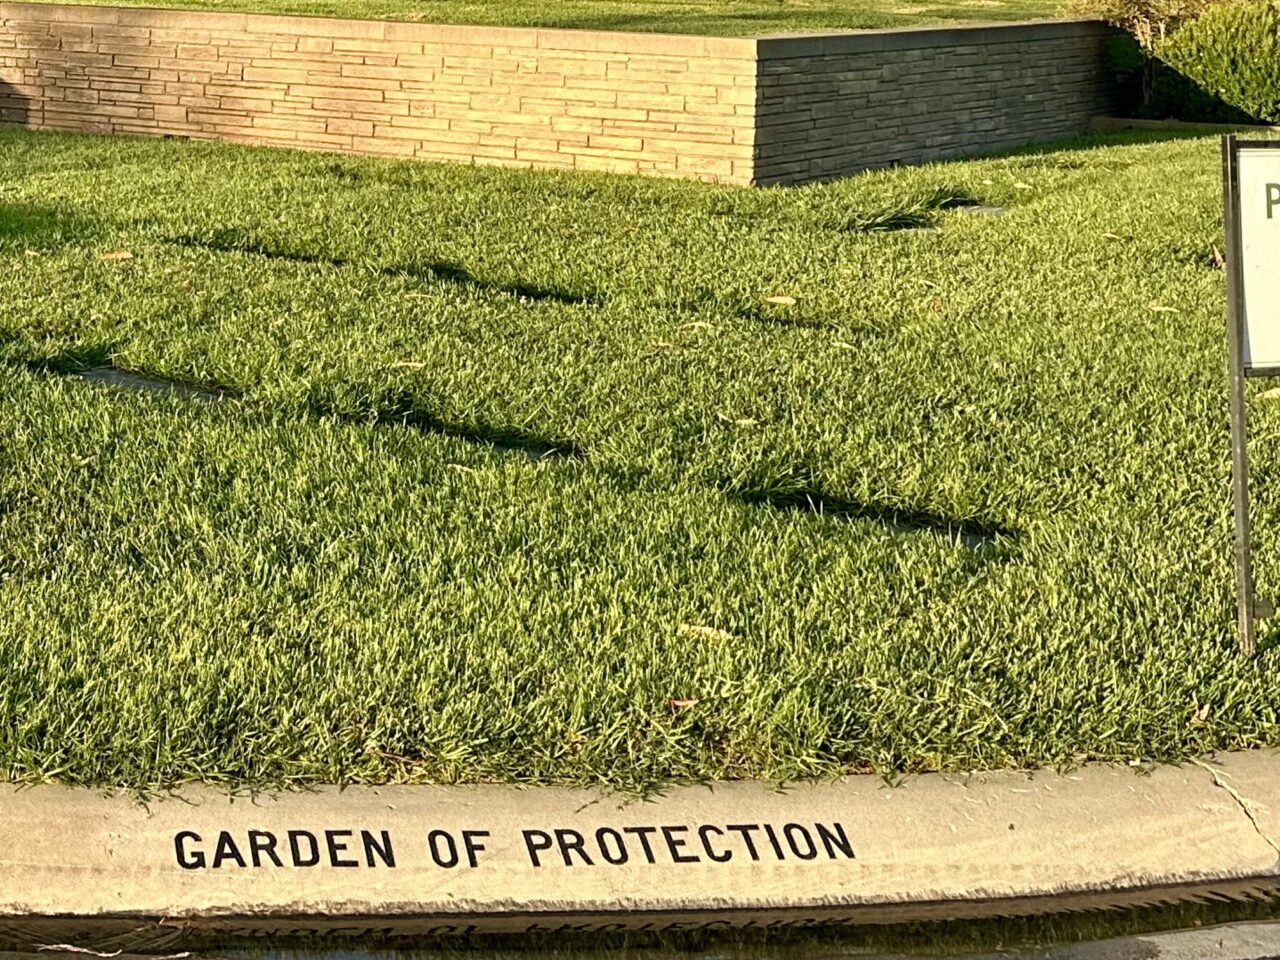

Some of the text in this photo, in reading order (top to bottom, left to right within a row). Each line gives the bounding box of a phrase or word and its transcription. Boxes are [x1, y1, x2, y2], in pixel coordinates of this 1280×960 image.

[175, 823, 856, 869] GARDEN OF PROTECTION
